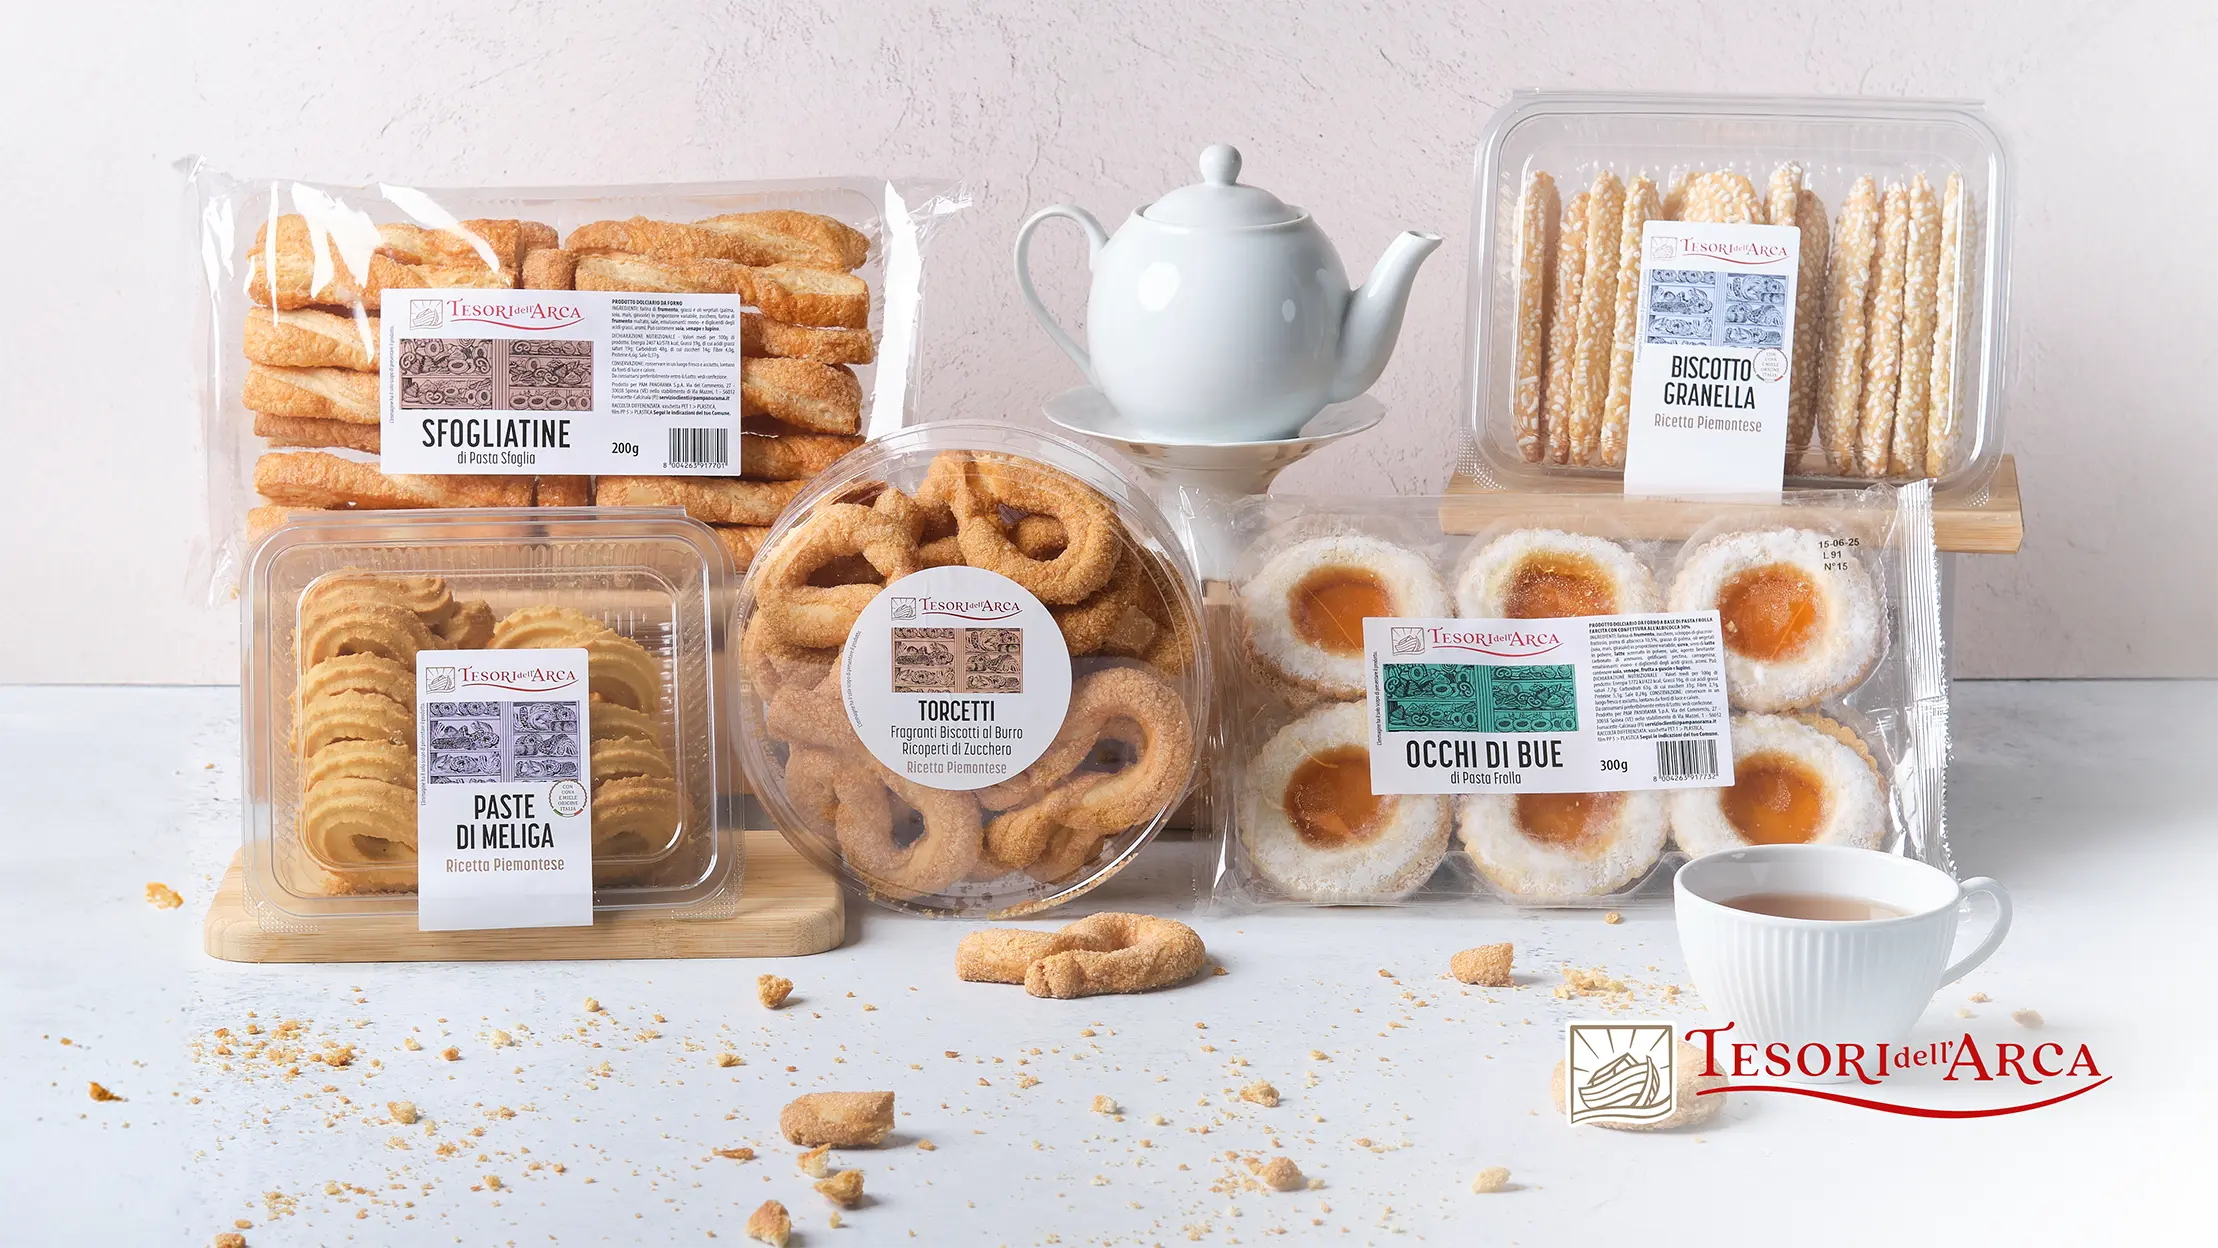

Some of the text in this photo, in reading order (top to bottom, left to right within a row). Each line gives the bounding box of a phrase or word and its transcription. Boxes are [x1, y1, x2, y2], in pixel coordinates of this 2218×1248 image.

[1671, 355, 1750, 382] BISCOTTO
[1664, 382, 1755, 409] GRANELLA
[1654, 413, 1762, 432] Ricetta Piemontese
[422, 418, 570, 448] SFOGLIATINE
[612, 442, 639, 456] 200g
[458, 452, 535, 466] di Pasta Sfoglia
[1819, 538, 1860, 548] 15-06-25
[919, 700, 994, 722] TORCETTI
[891, 726, 1023, 741] Fragranti Biscotti al Burro
[902, 742, 1011, 757] Ricoperti di Zucchero
[1406, 740, 1563, 768] OCCHI DI BUE
[907, 761, 1006, 774] Ricetta Piemontese
[1600, 760, 1628, 773] 300g
[1450, 772, 1521, 785] di Pasta Frolla
[474, 794, 534, 820] PASTE
[457, 823, 554, 849] DI MELIGA
[446, 858, 564, 873] Ricetta Piemontese
